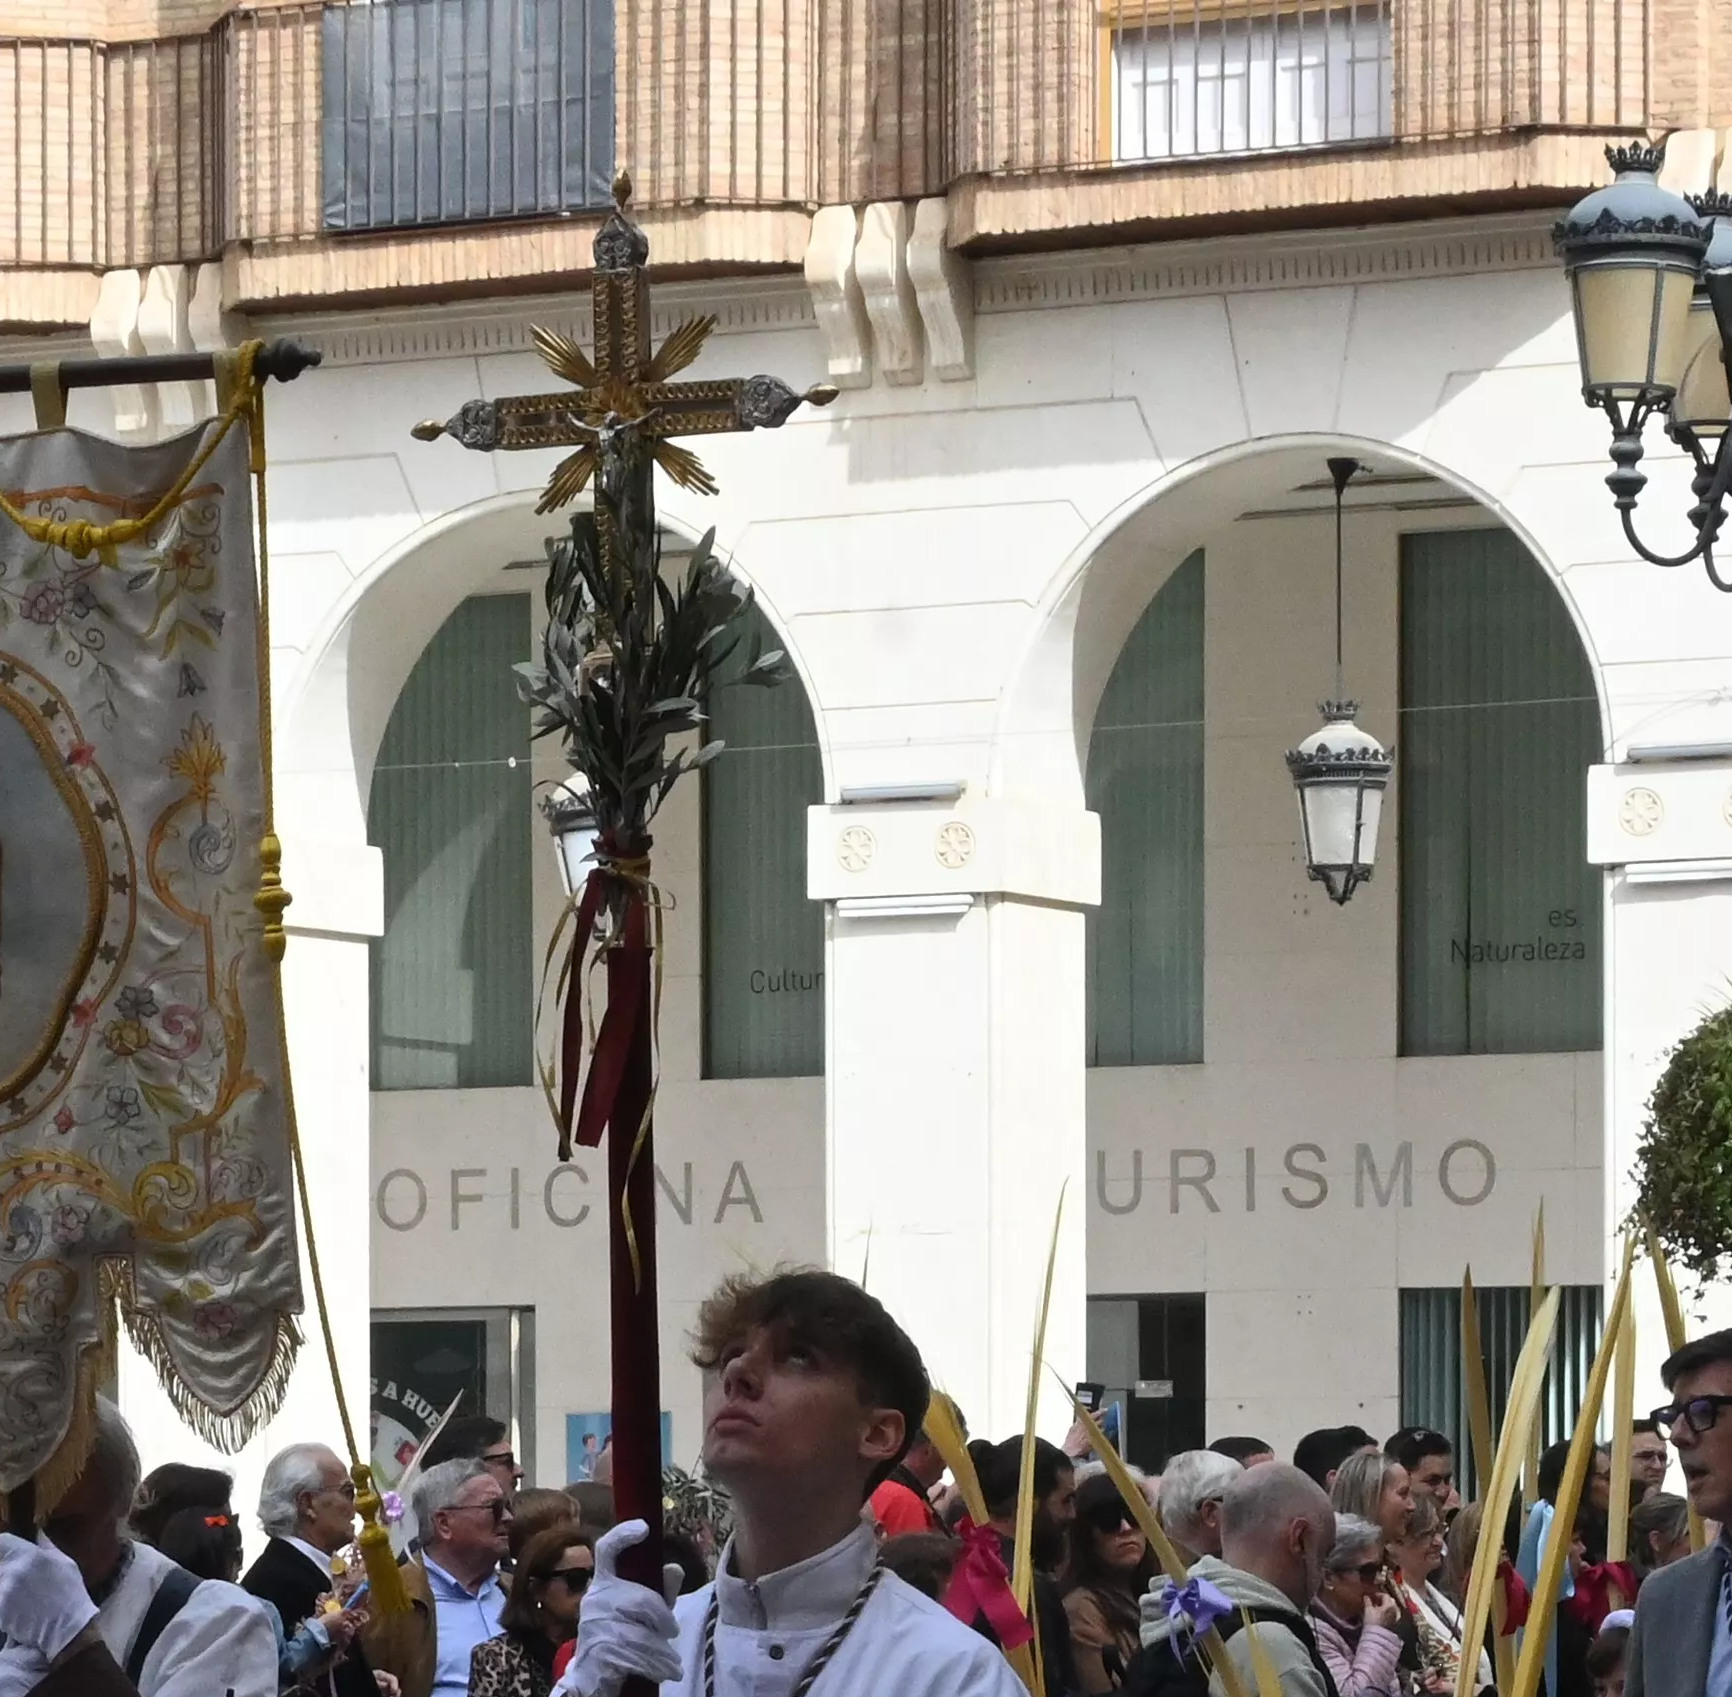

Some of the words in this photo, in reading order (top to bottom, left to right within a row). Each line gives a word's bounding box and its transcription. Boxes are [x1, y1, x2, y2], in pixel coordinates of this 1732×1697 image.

[1548, 909, 1577, 928] es
[1450, 935, 1586, 964] Naturaleza
[749, 968, 825, 994] Cultur
[375, 1159, 764, 1232] OFICNA
[1095, 1137, 1497, 1216] URISMO
[381, 1380, 398, 1400] A
